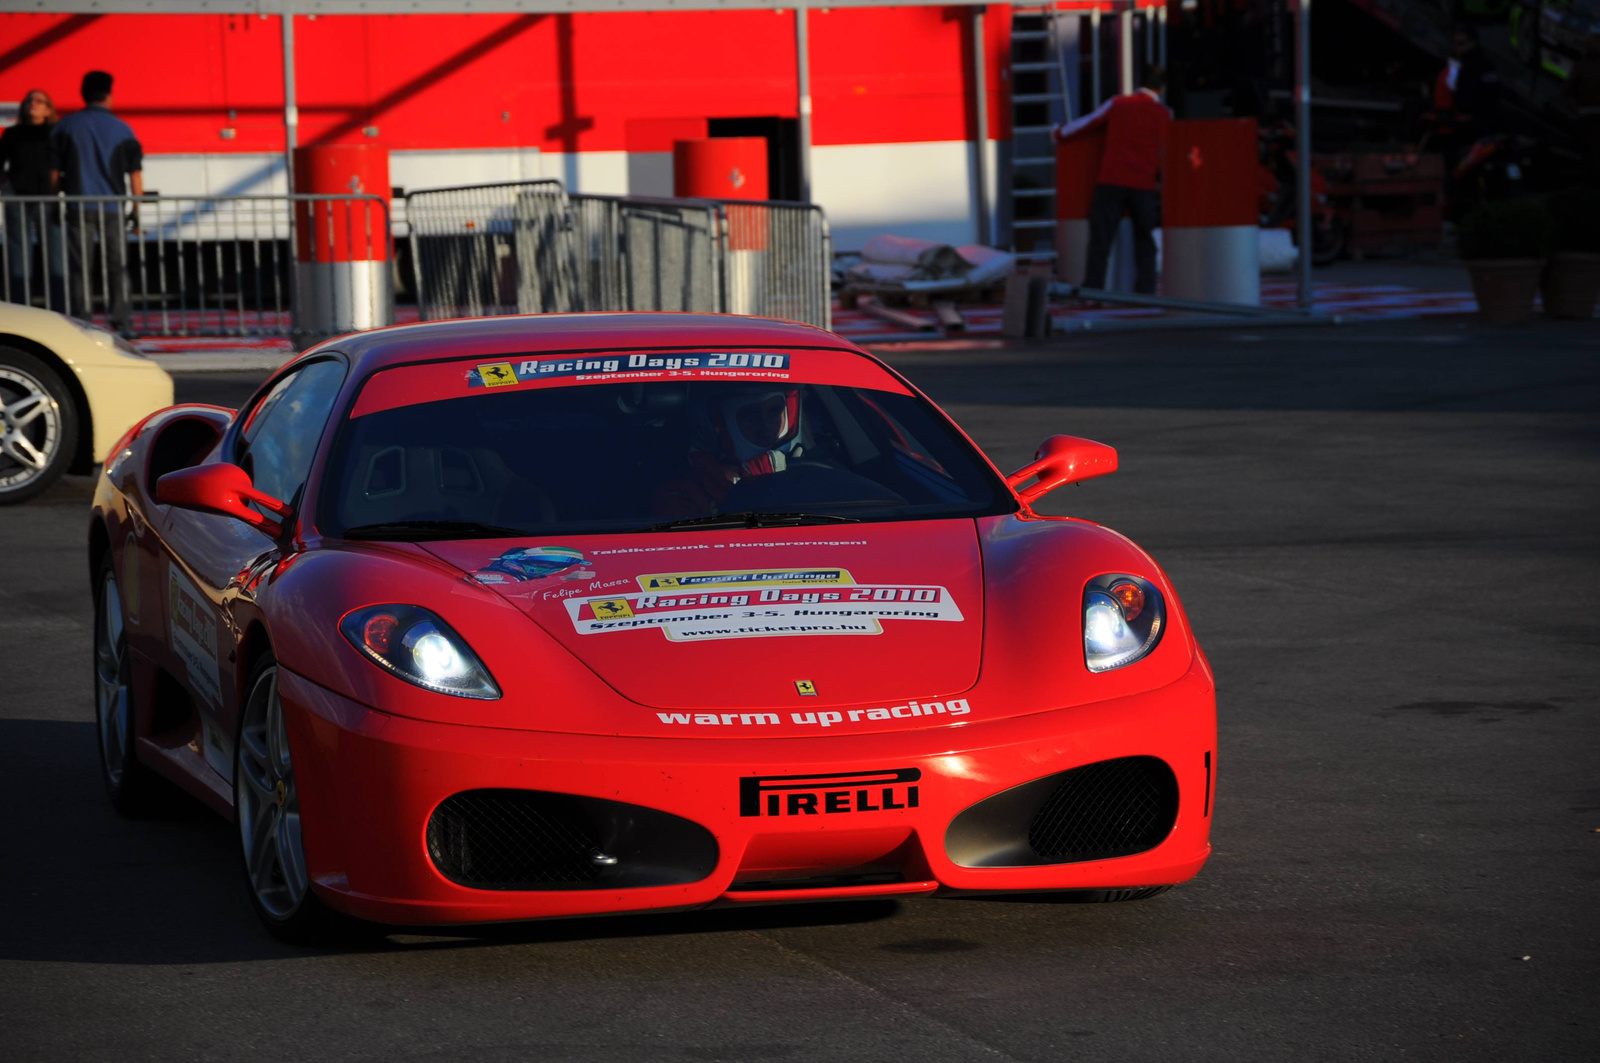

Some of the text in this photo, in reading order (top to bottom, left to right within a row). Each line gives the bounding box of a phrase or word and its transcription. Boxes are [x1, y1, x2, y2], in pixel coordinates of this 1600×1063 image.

[519, 353, 784, 374] Racing Days 2010
[576, 371, 663, 380] Szeptember
[701, 370, 789, 379] Hungaroring
[679, 571, 837, 584] Ferrari Challenge
[543, 579, 631, 601] Felipe Massa
[637, 588, 938, 609] Racing Days 2010
[590, 608, 938, 630] Szeptember 3-5. Hungaroring
[681, 624, 866, 636] www.ticketpro.hu
[656, 698, 971, 727] warm up racing
[739, 767, 922, 817] PIRELLI
